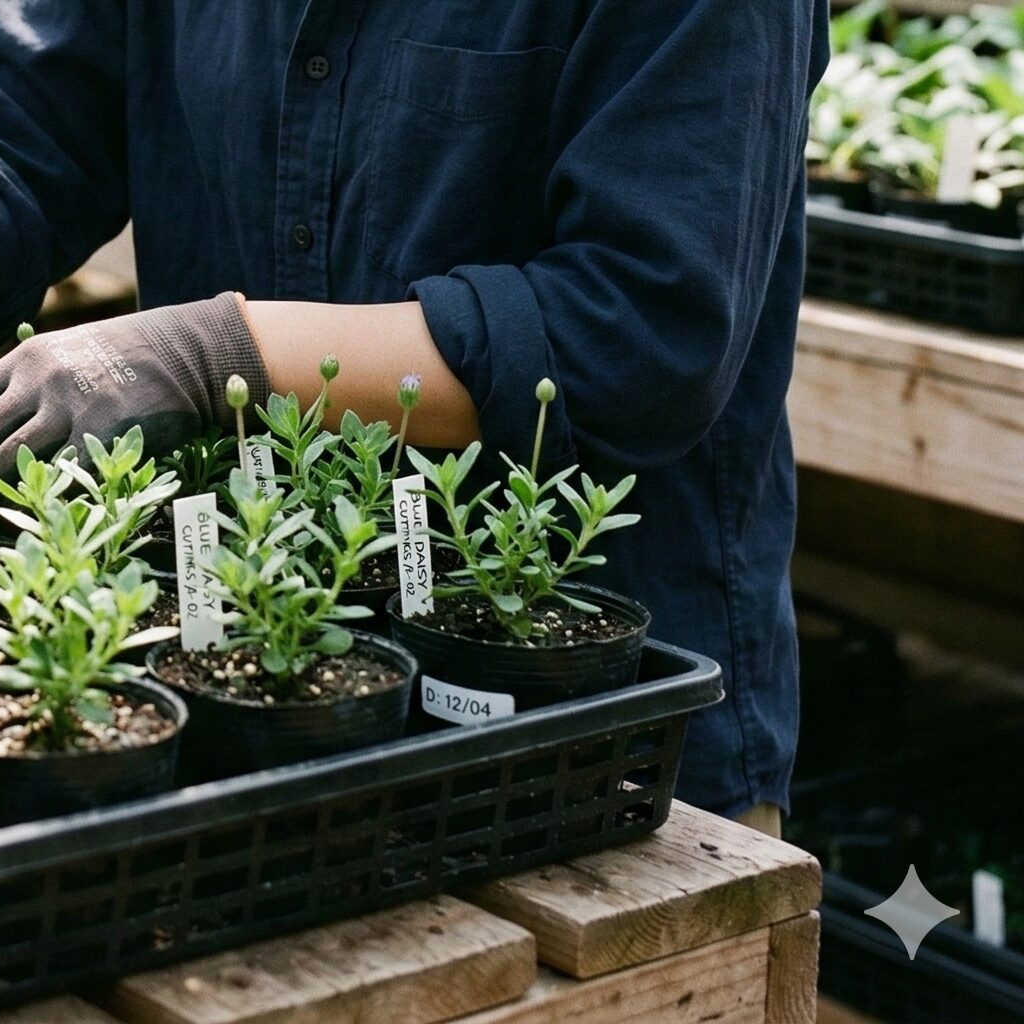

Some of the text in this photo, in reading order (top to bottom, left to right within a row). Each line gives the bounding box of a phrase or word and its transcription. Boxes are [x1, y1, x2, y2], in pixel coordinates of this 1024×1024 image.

[197, 511, 212, 556] BLUE
[414, 541, 428, 590] DAISY
[426, 686, 491, 717] D: 12/04
